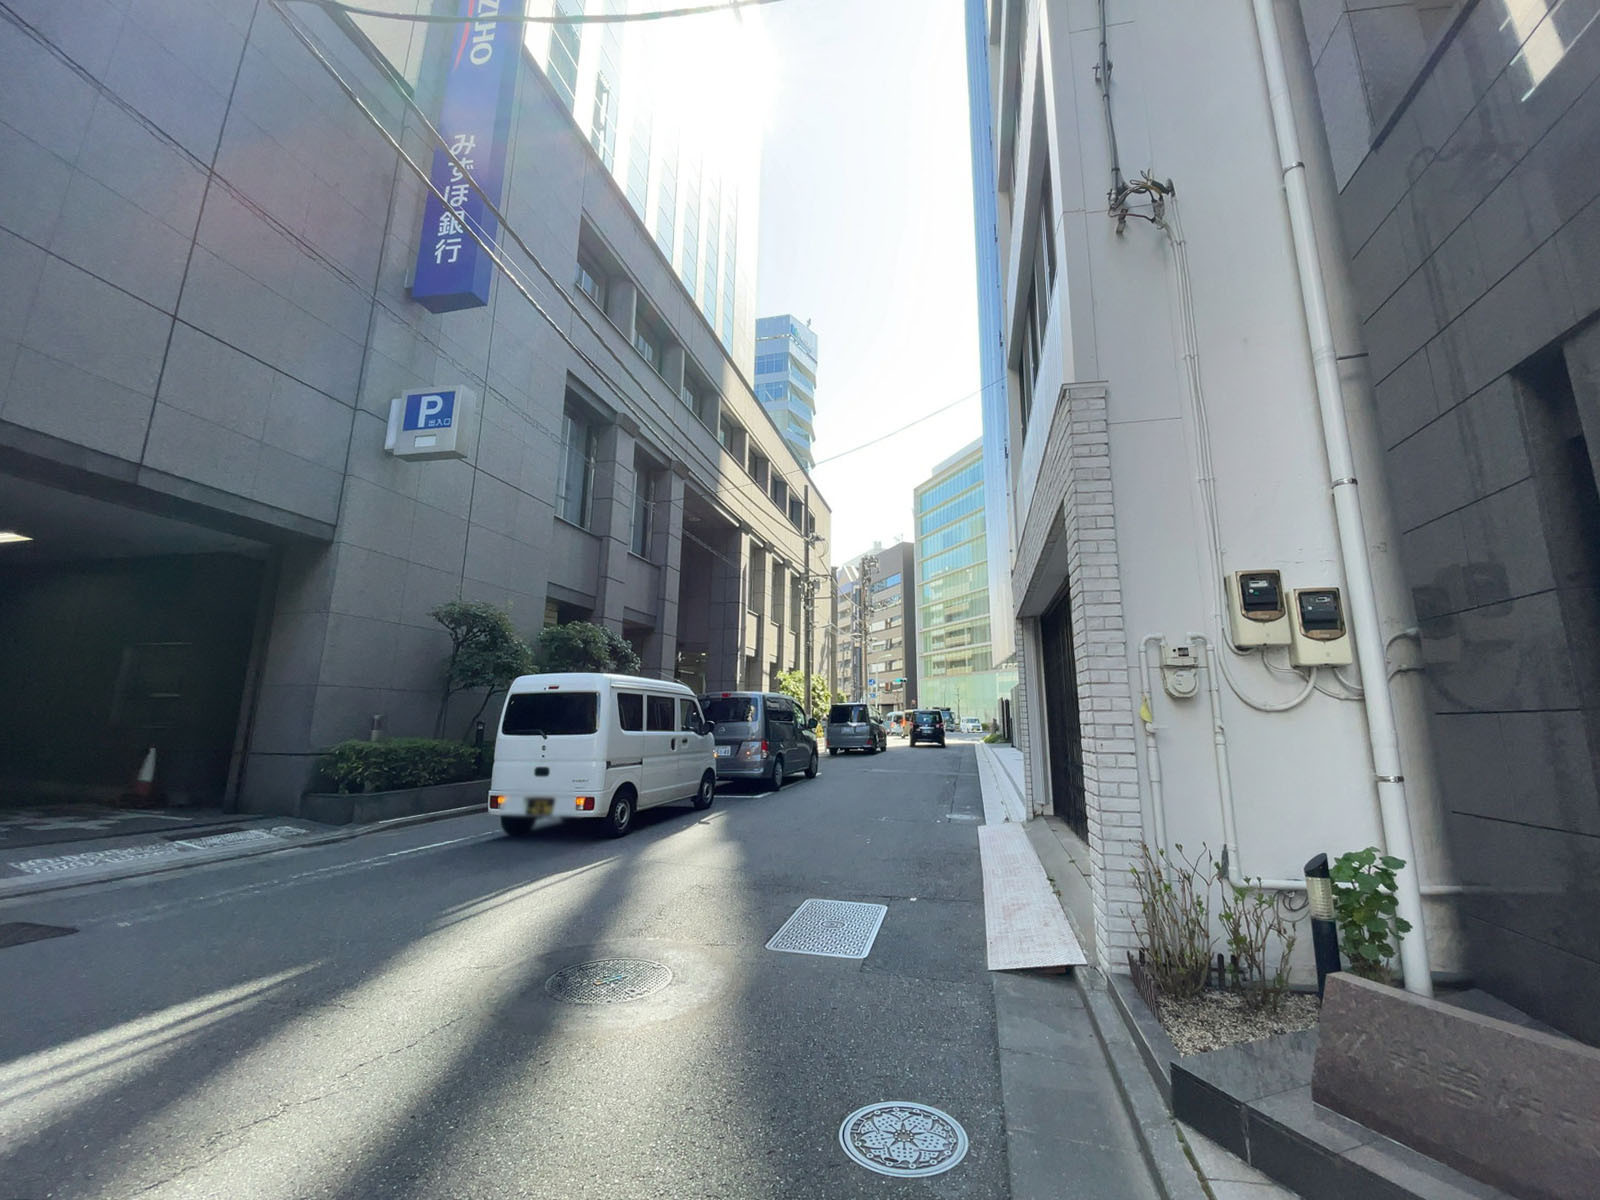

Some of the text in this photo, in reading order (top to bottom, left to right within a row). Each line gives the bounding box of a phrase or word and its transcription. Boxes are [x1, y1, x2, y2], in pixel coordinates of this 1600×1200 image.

[434, 134, 476, 264] みずほ銀行
[418, 395, 443, 428] P
[428, 418, 451, 427] 出入口
